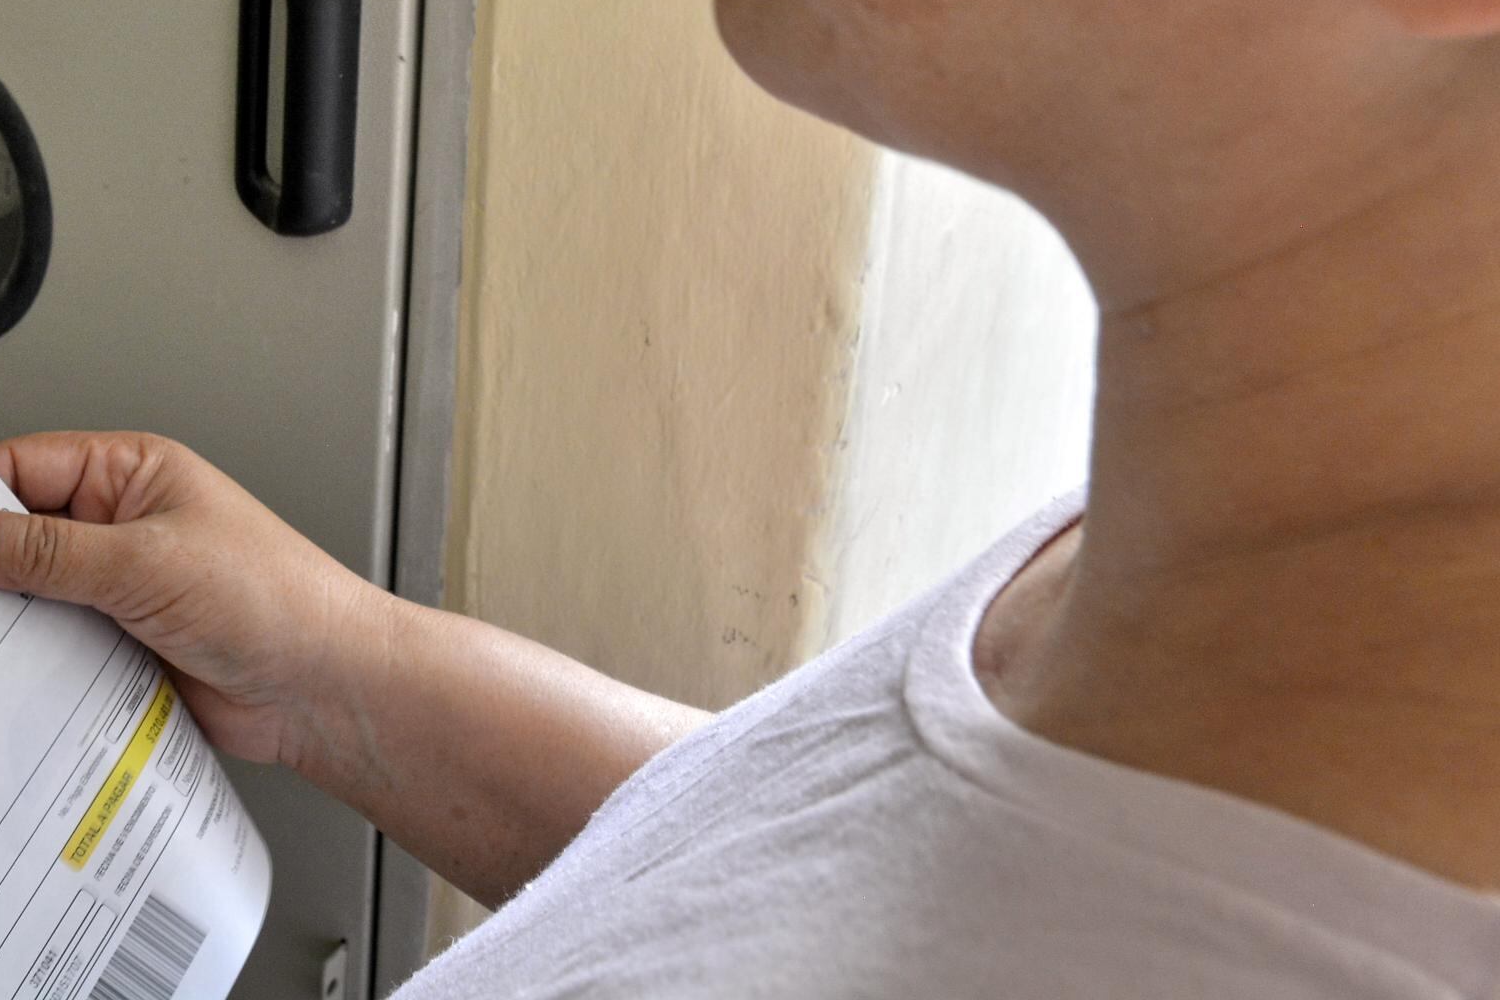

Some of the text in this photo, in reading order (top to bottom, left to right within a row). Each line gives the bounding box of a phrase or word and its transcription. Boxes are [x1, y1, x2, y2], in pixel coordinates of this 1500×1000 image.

[71, 774, 132, 861] TOTAL A PAGAR
